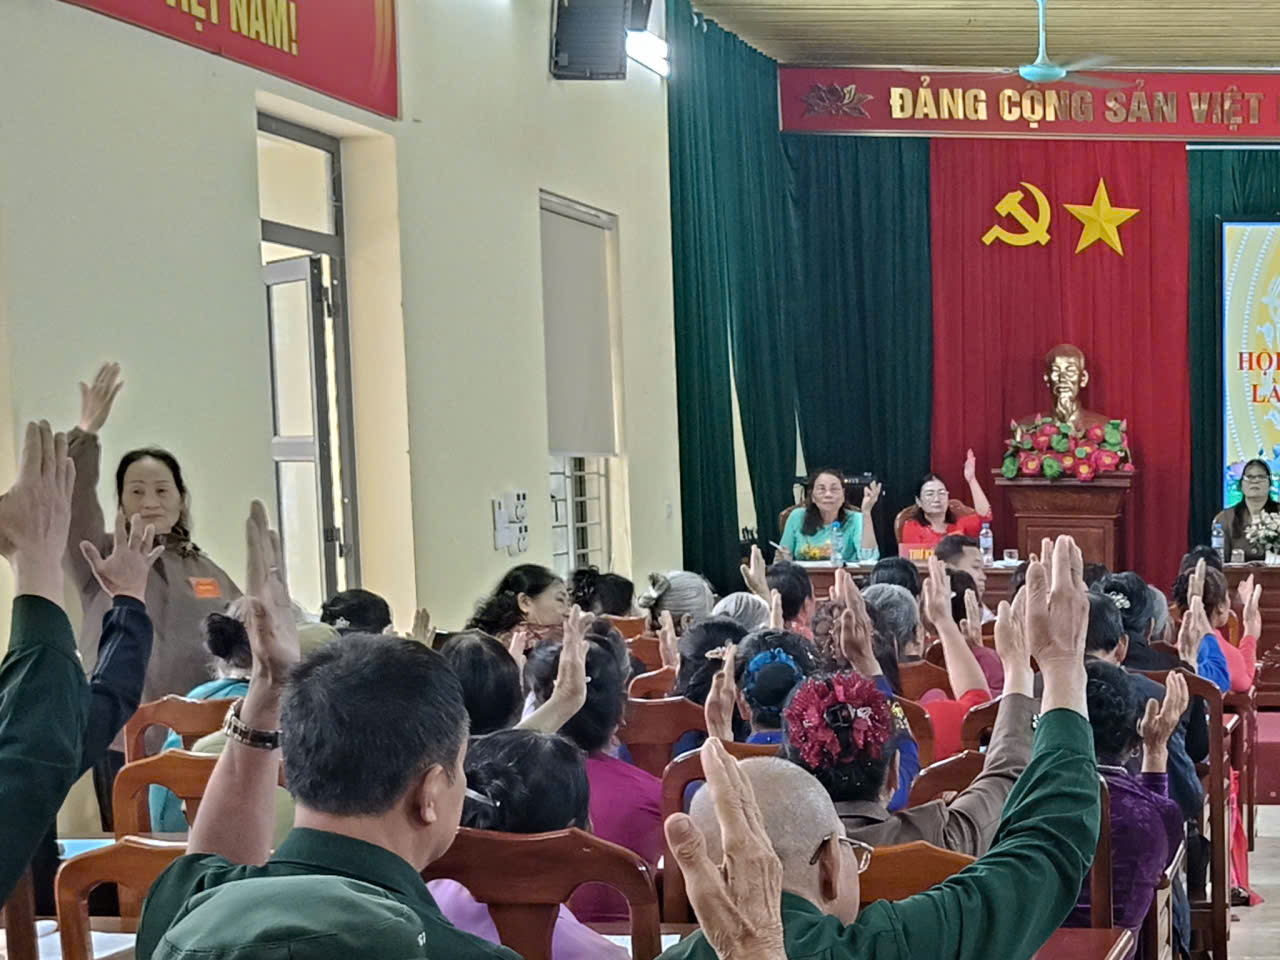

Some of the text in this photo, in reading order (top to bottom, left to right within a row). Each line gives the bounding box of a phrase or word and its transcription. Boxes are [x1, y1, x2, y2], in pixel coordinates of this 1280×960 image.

[890, 75, 988, 120] ĐẢNG
[1000, 83, 1093, 128] CỘNG
[1104, 79, 1178, 123] SẢN
[1189, 85, 1265, 131] VIỆT
